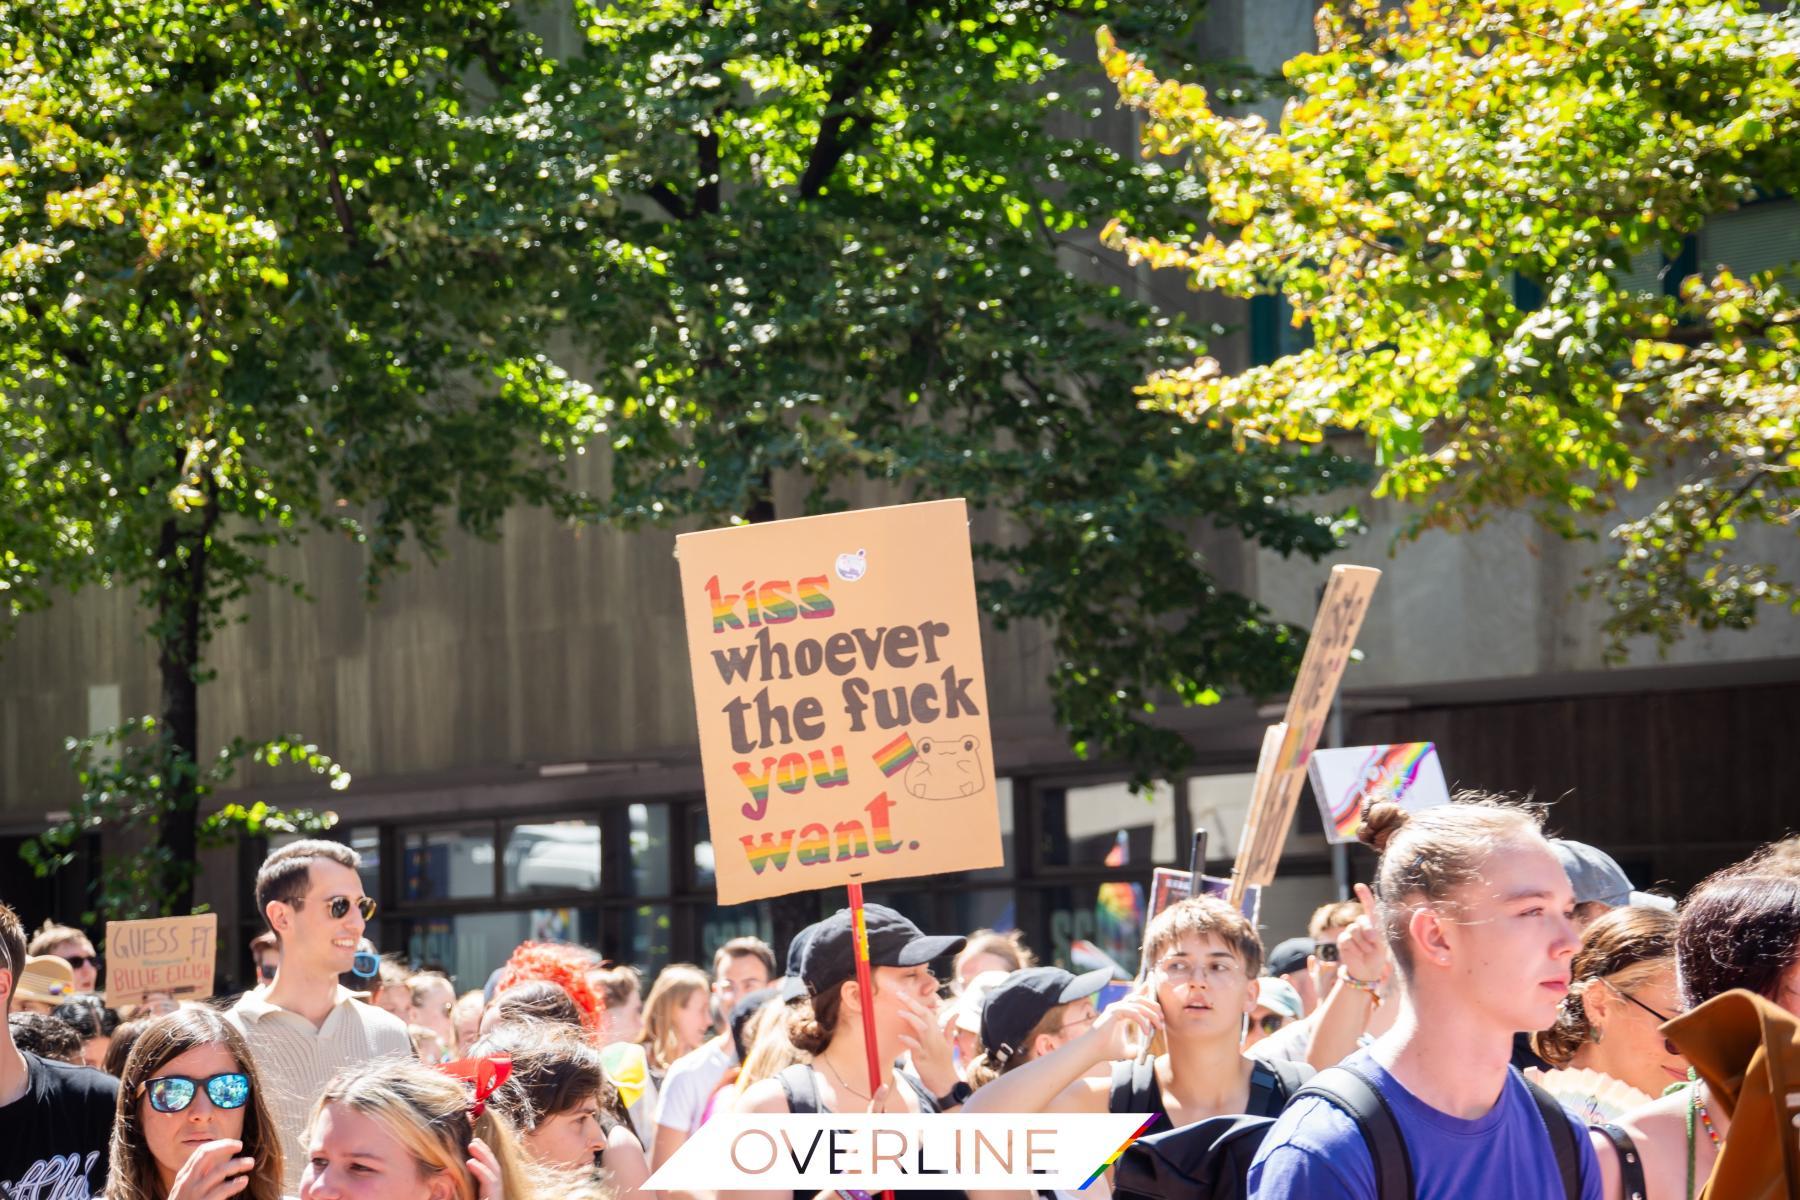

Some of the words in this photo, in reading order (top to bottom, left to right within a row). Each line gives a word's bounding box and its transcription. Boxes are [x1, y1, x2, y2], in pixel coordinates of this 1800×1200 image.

[704, 574, 836, 634] kiss
[710, 620, 950, 686] whoever
[721, 686, 826, 755] the
[842, 665, 981, 732] fuck
[732, 745, 850, 821] you
[738, 791, 921, 876] want.
[113, 926, 179, 958] GUESS
[113, 966, 161, 992] BILLIE
[166, 963, 212, 983] EILISH
